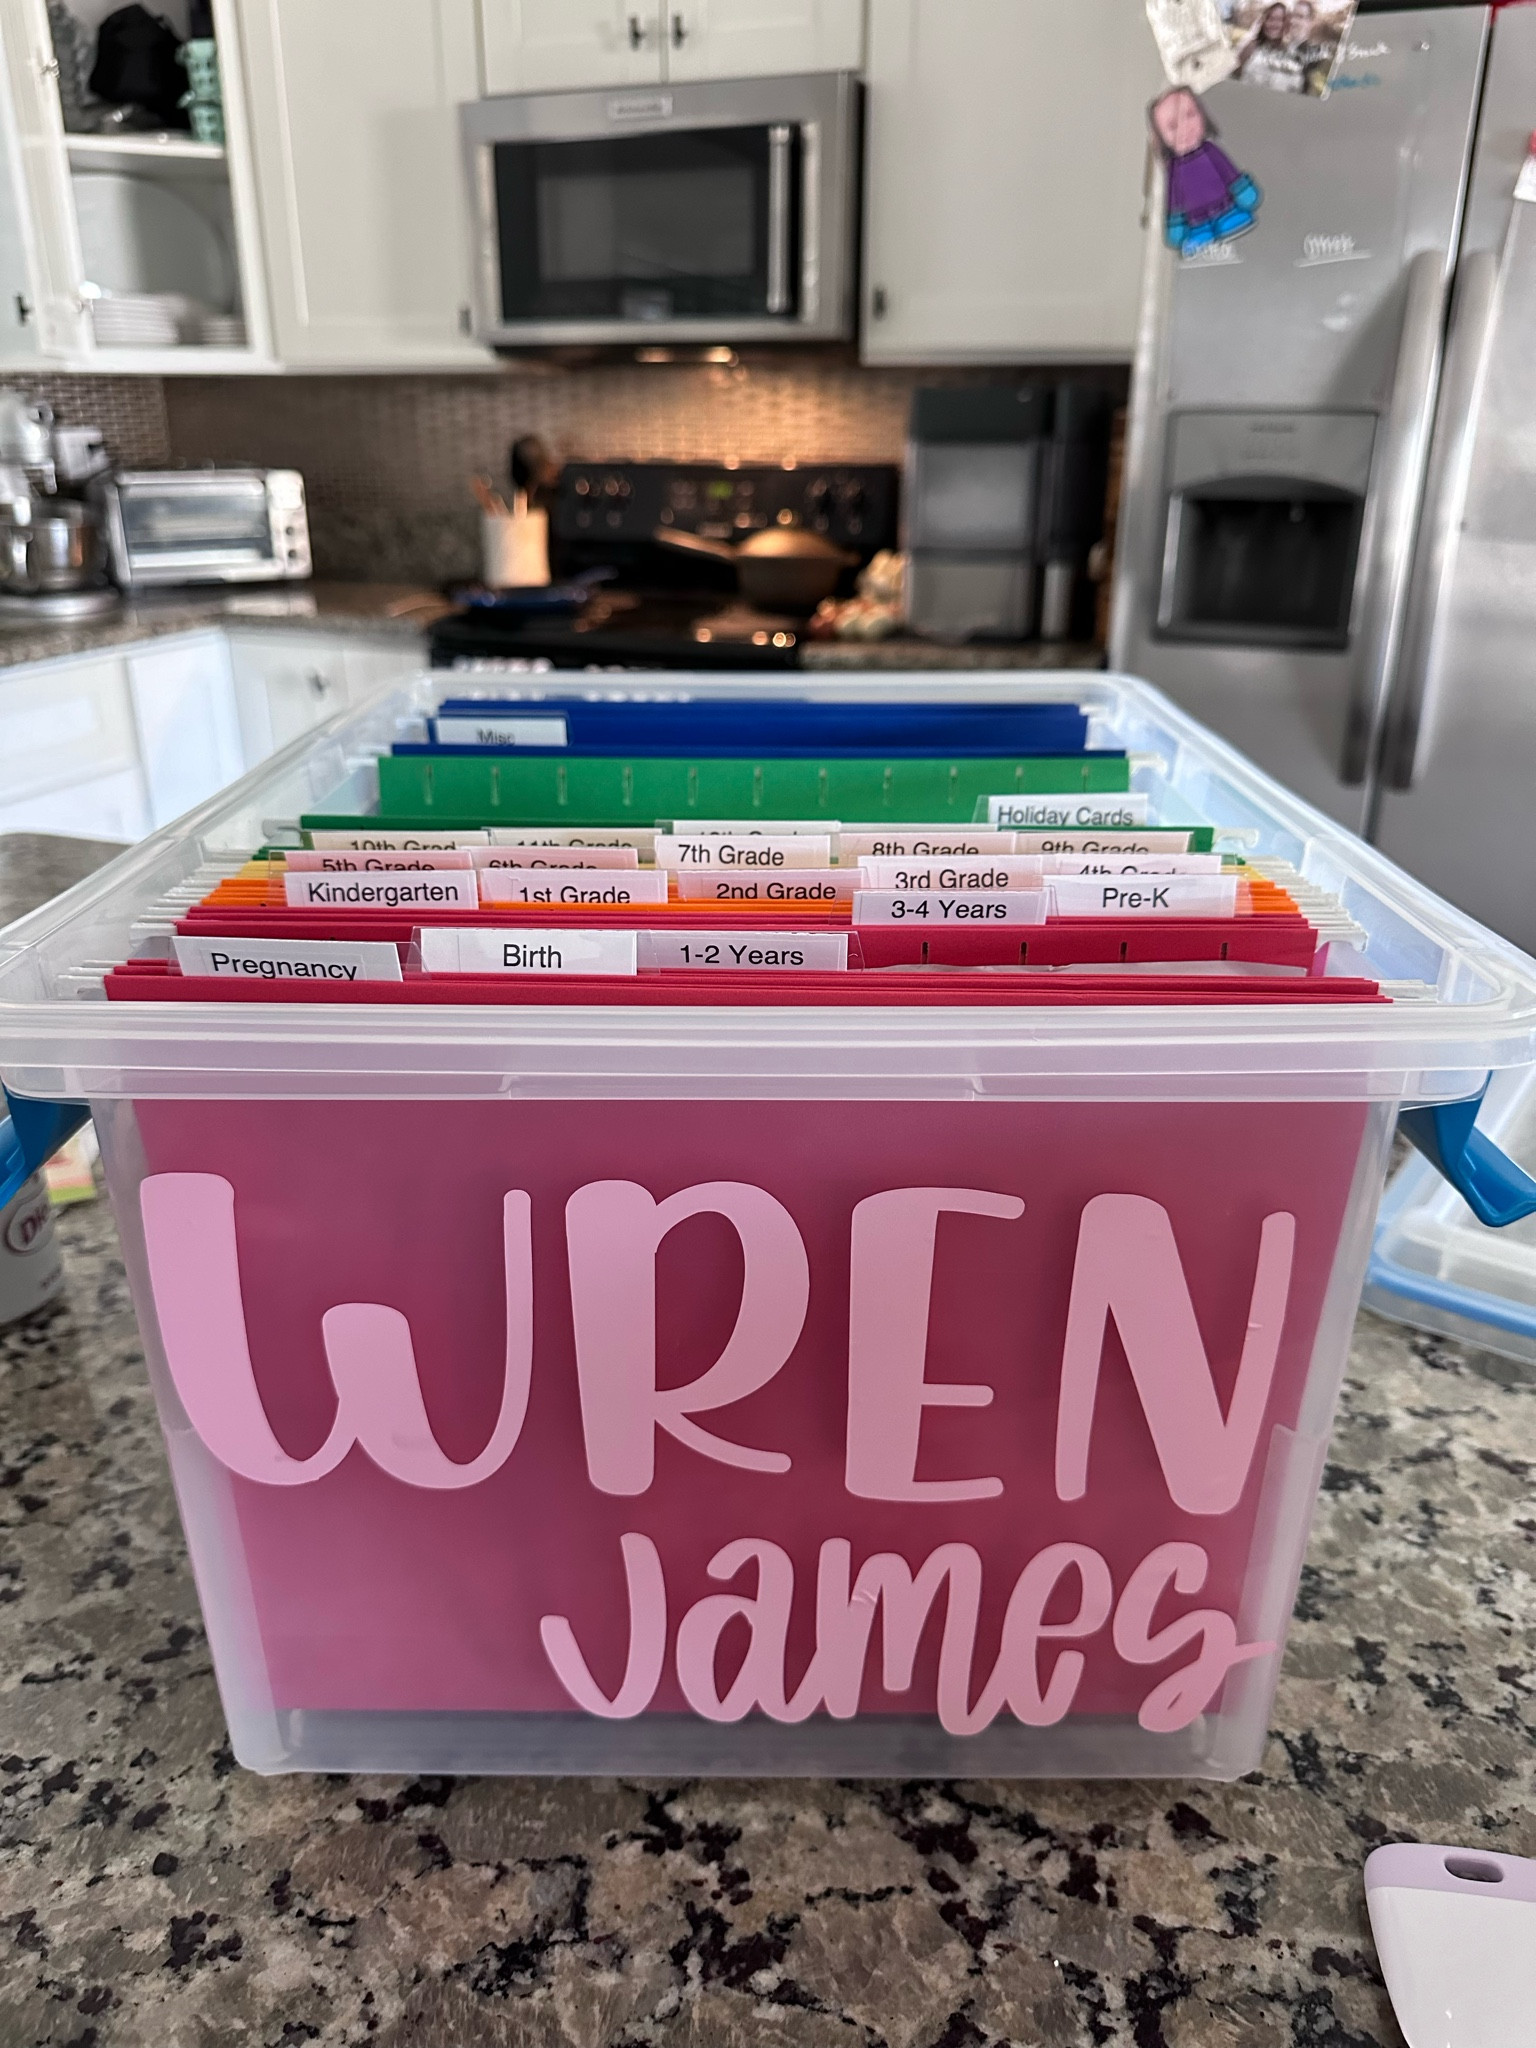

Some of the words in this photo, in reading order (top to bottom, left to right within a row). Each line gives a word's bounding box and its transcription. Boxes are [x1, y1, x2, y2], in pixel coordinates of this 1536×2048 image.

[998, 806, 1070, 826] Holiday
[1076, 806, 1134, 827] Cards
[678, 844, 711, 864] 7th
[718, 844, 785, 867] Grade
[872, 841, 905, 856] 8th
[913, 841, 980, 856] Grade
[322, 859, 357, 871] 5th
[895, 869, 931, 889] 3rd
[938, 867, 1010, 889] Grade
[308, 882, 459, 907] Kindergarten
[519, 886, 553, 904] 1st
[560, 885, 631, 904] Grade
[716, 882, 758, 900] 2nd
[766, 882, 837, 901] Grade
[1102, 886, 1171, 909] Pre-K
[891, 899, 930, 919] 3-4
[938, 899, 1008, 919] Years
[502, 943, 563, 969] Birth
[680, 944, 721, 964] 1-2
[728, 944, 805, 966] Years
[211, 952, 358, 982] Pregnancy
[139, 1171, 1297, 1516] WREN
